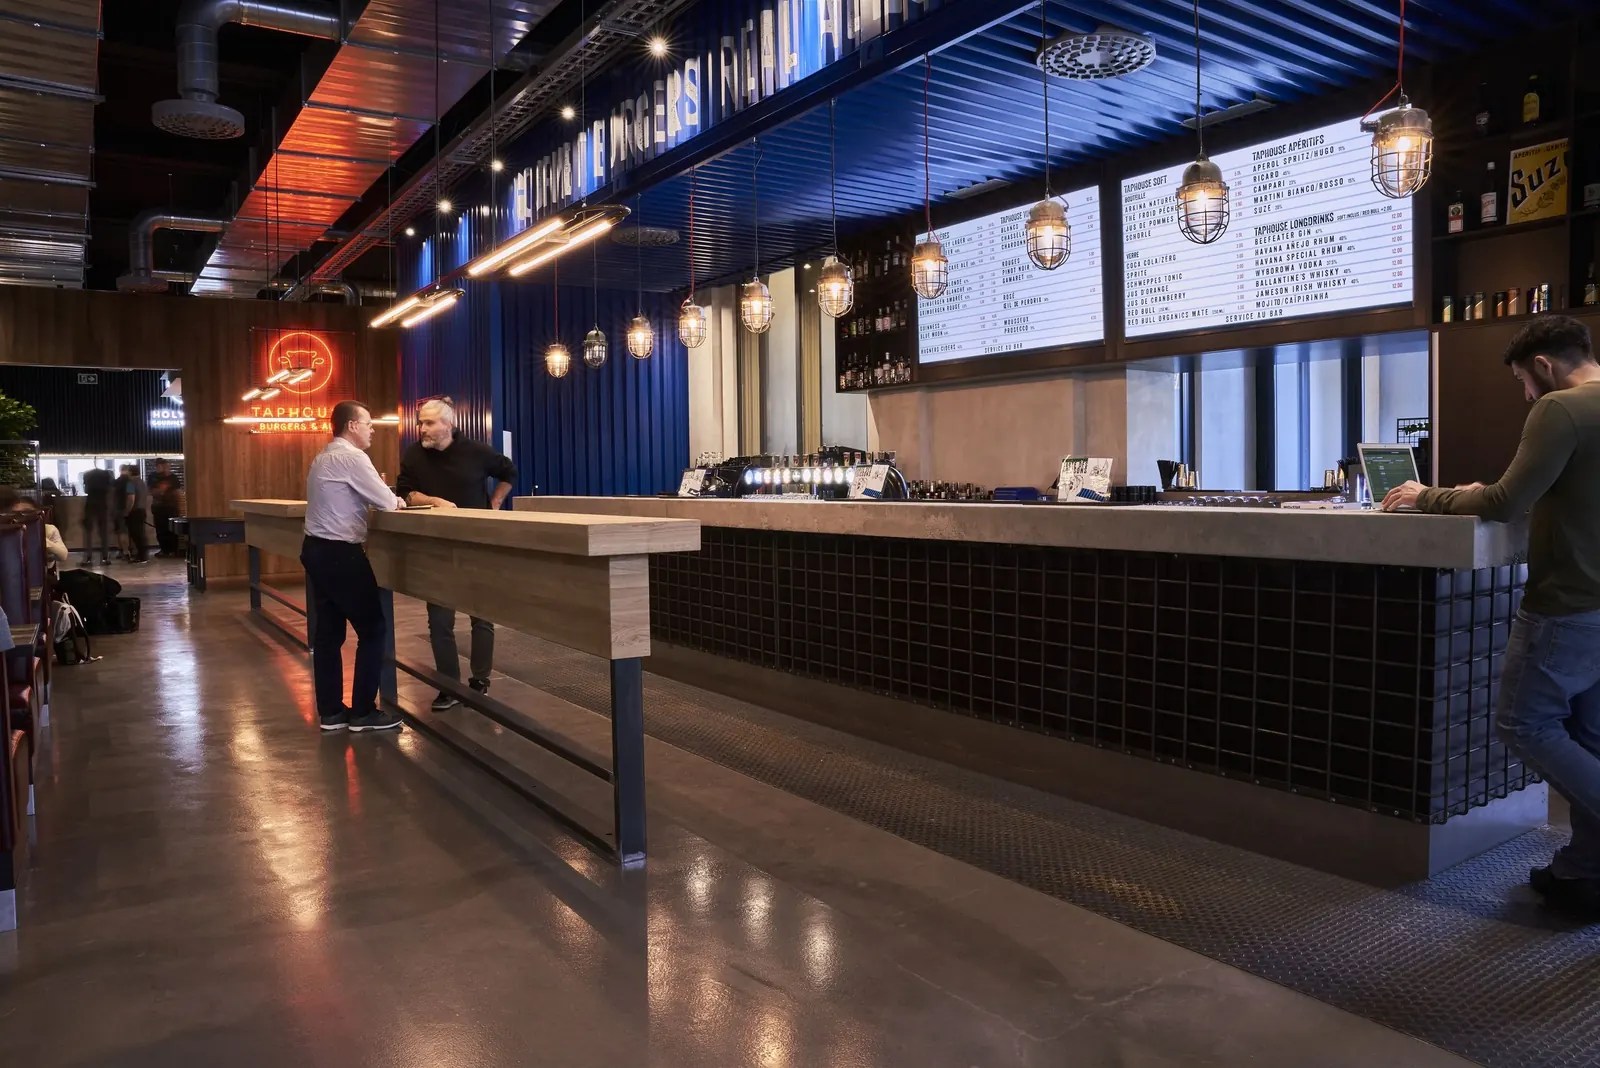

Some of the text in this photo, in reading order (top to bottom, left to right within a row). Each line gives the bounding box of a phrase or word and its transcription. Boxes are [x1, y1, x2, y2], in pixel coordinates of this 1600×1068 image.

[593, 58, 699, 177] BURGERS
[1252, 134, 1325, 161] TAPHOUSE APÉRITIFS
[1252, 160, 1280, 172] APEROL
[1283, 146, 1334, 165] SPRITZ/HUGO
[1253, 170, 1279, 183] RICARD
[1511, 155, 1568, 209] Suz
[1124, 175, 1167, 194] TAPHOUSE SOFT
[1253, 180, 1285, 194] CAMPARI
[1253, 191, 1284, 204] MARTINI
[1287, 177, 1344, 197] BIANCO/ROSSO
[1125, 192, 1146, 203] BOUTEILLE
[1125, 203, 1146, 213] ARKINA
[1253, 204, 1271, 215] SUZE
[1000, 211, 1023, 225] TAPHOUSE
[1125, 213, 1136, 223] THÉ
[1139, 209, 1156, 220] FROID
[1125, 223, 1137, 232] JUS
[1149, 215, 1174, 227] POMMES
[1254, 221, 1288, 237] TAPHOUSE
[1289, 212, 1334, 230] LONGDRINKS
[1125, 230, 1151, 242] SCHORLE
[1254, 232, 1295, 246] BEEFEATER
[1298, 228, 1311, 238] GIN
[1255, 244, 1282, 256] HAVANA
[1286, 239, 1309, 250] AÑEJO
[1313, 235, 1335, 246] RHUM
[1126, 251, 1139, 259] VERRE
[1255, 255, 1283, 267] HAVANA
[1286, 249, 1317, 261] SPECIAL
[1321, 245, 1343, 255] RHUM
[1002, 264, 1030, 276] PINOT NOIR
[1126, 261, 1141, 269] COCA
[1255, 264, 1295, 277] WYBOROWA
[1299, 259, 1322, 270] VODKA
[1126, 269, 1147, 279] SPRITE
[1126, 273, 1183, 289] SCHWEPPES TONIC
[1255, 273, 1306, 288] BALLANTINE'S
[1309, 267, 1339, 279] WHISKY
[1127, 285, 1169, 298] JUS D'ORANGE
[1255, 286, 1289, 298] JAMESON
[1292, 283, 1313, 293] IRISH
[1316, 278, 1347, 289] WHISKY
[1150, 292, 1186, 304] CRANBERRY
[1141, 307, 1155, 315] BULL
[1141, 316, 1155, 324] BULL
[1158, 311, 1189, 321] ORGANICS
[1191, 309, 1209, 317] MATE
[1225, 308, 1283, 323] SERVICE AU BAR
[1004, 325, 1028, 334] PROSECCO
[251, 406, 334, 418] TAPHOU
[259, 422, 307, 431] BURGERS
[311, 422, 318, 431] &
